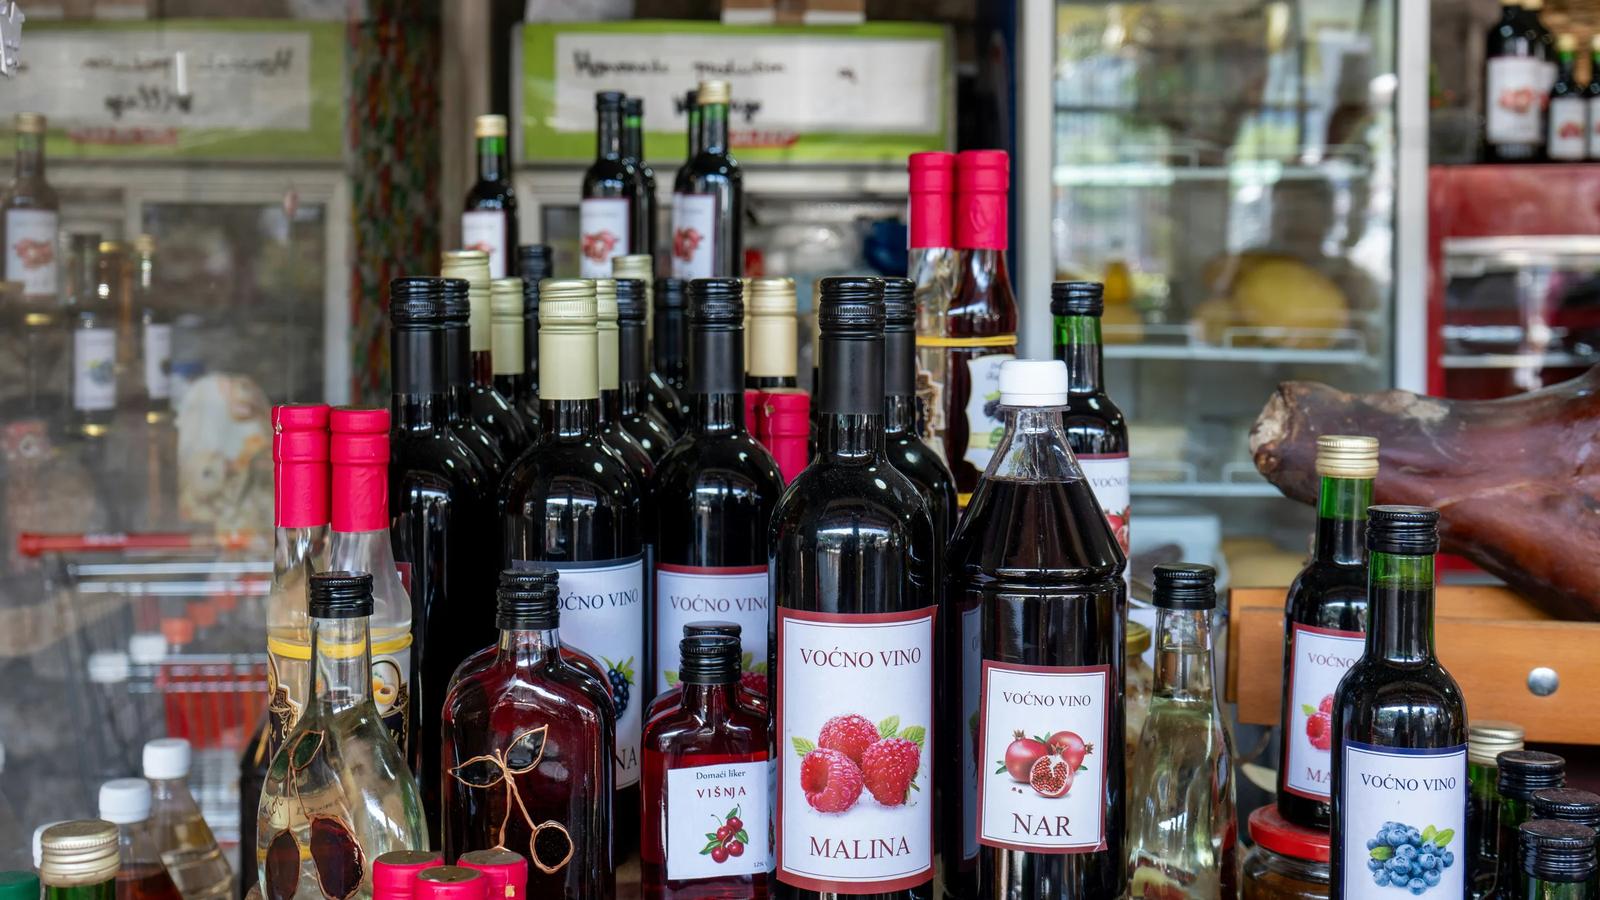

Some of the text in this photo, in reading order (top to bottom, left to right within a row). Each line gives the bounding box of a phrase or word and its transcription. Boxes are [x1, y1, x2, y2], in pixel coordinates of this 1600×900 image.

[559, 587, 639, 611] ĆNO VINO
[670, 594, 730, 613] VOĆNO
[800, 646, 921, 669] VOĆNO VINO
[1308, 652, 1356, 669] VOĆNO
[1003, 690, 1092, 707] VOĆNO VINO
[696, 769, 746, 780] Domaći liker
[1361, 773, 1456, 791] VOĆNO VINO
[1012, 812, 1072, 837] NAR
[809, 835, 911, 860] MALINA
